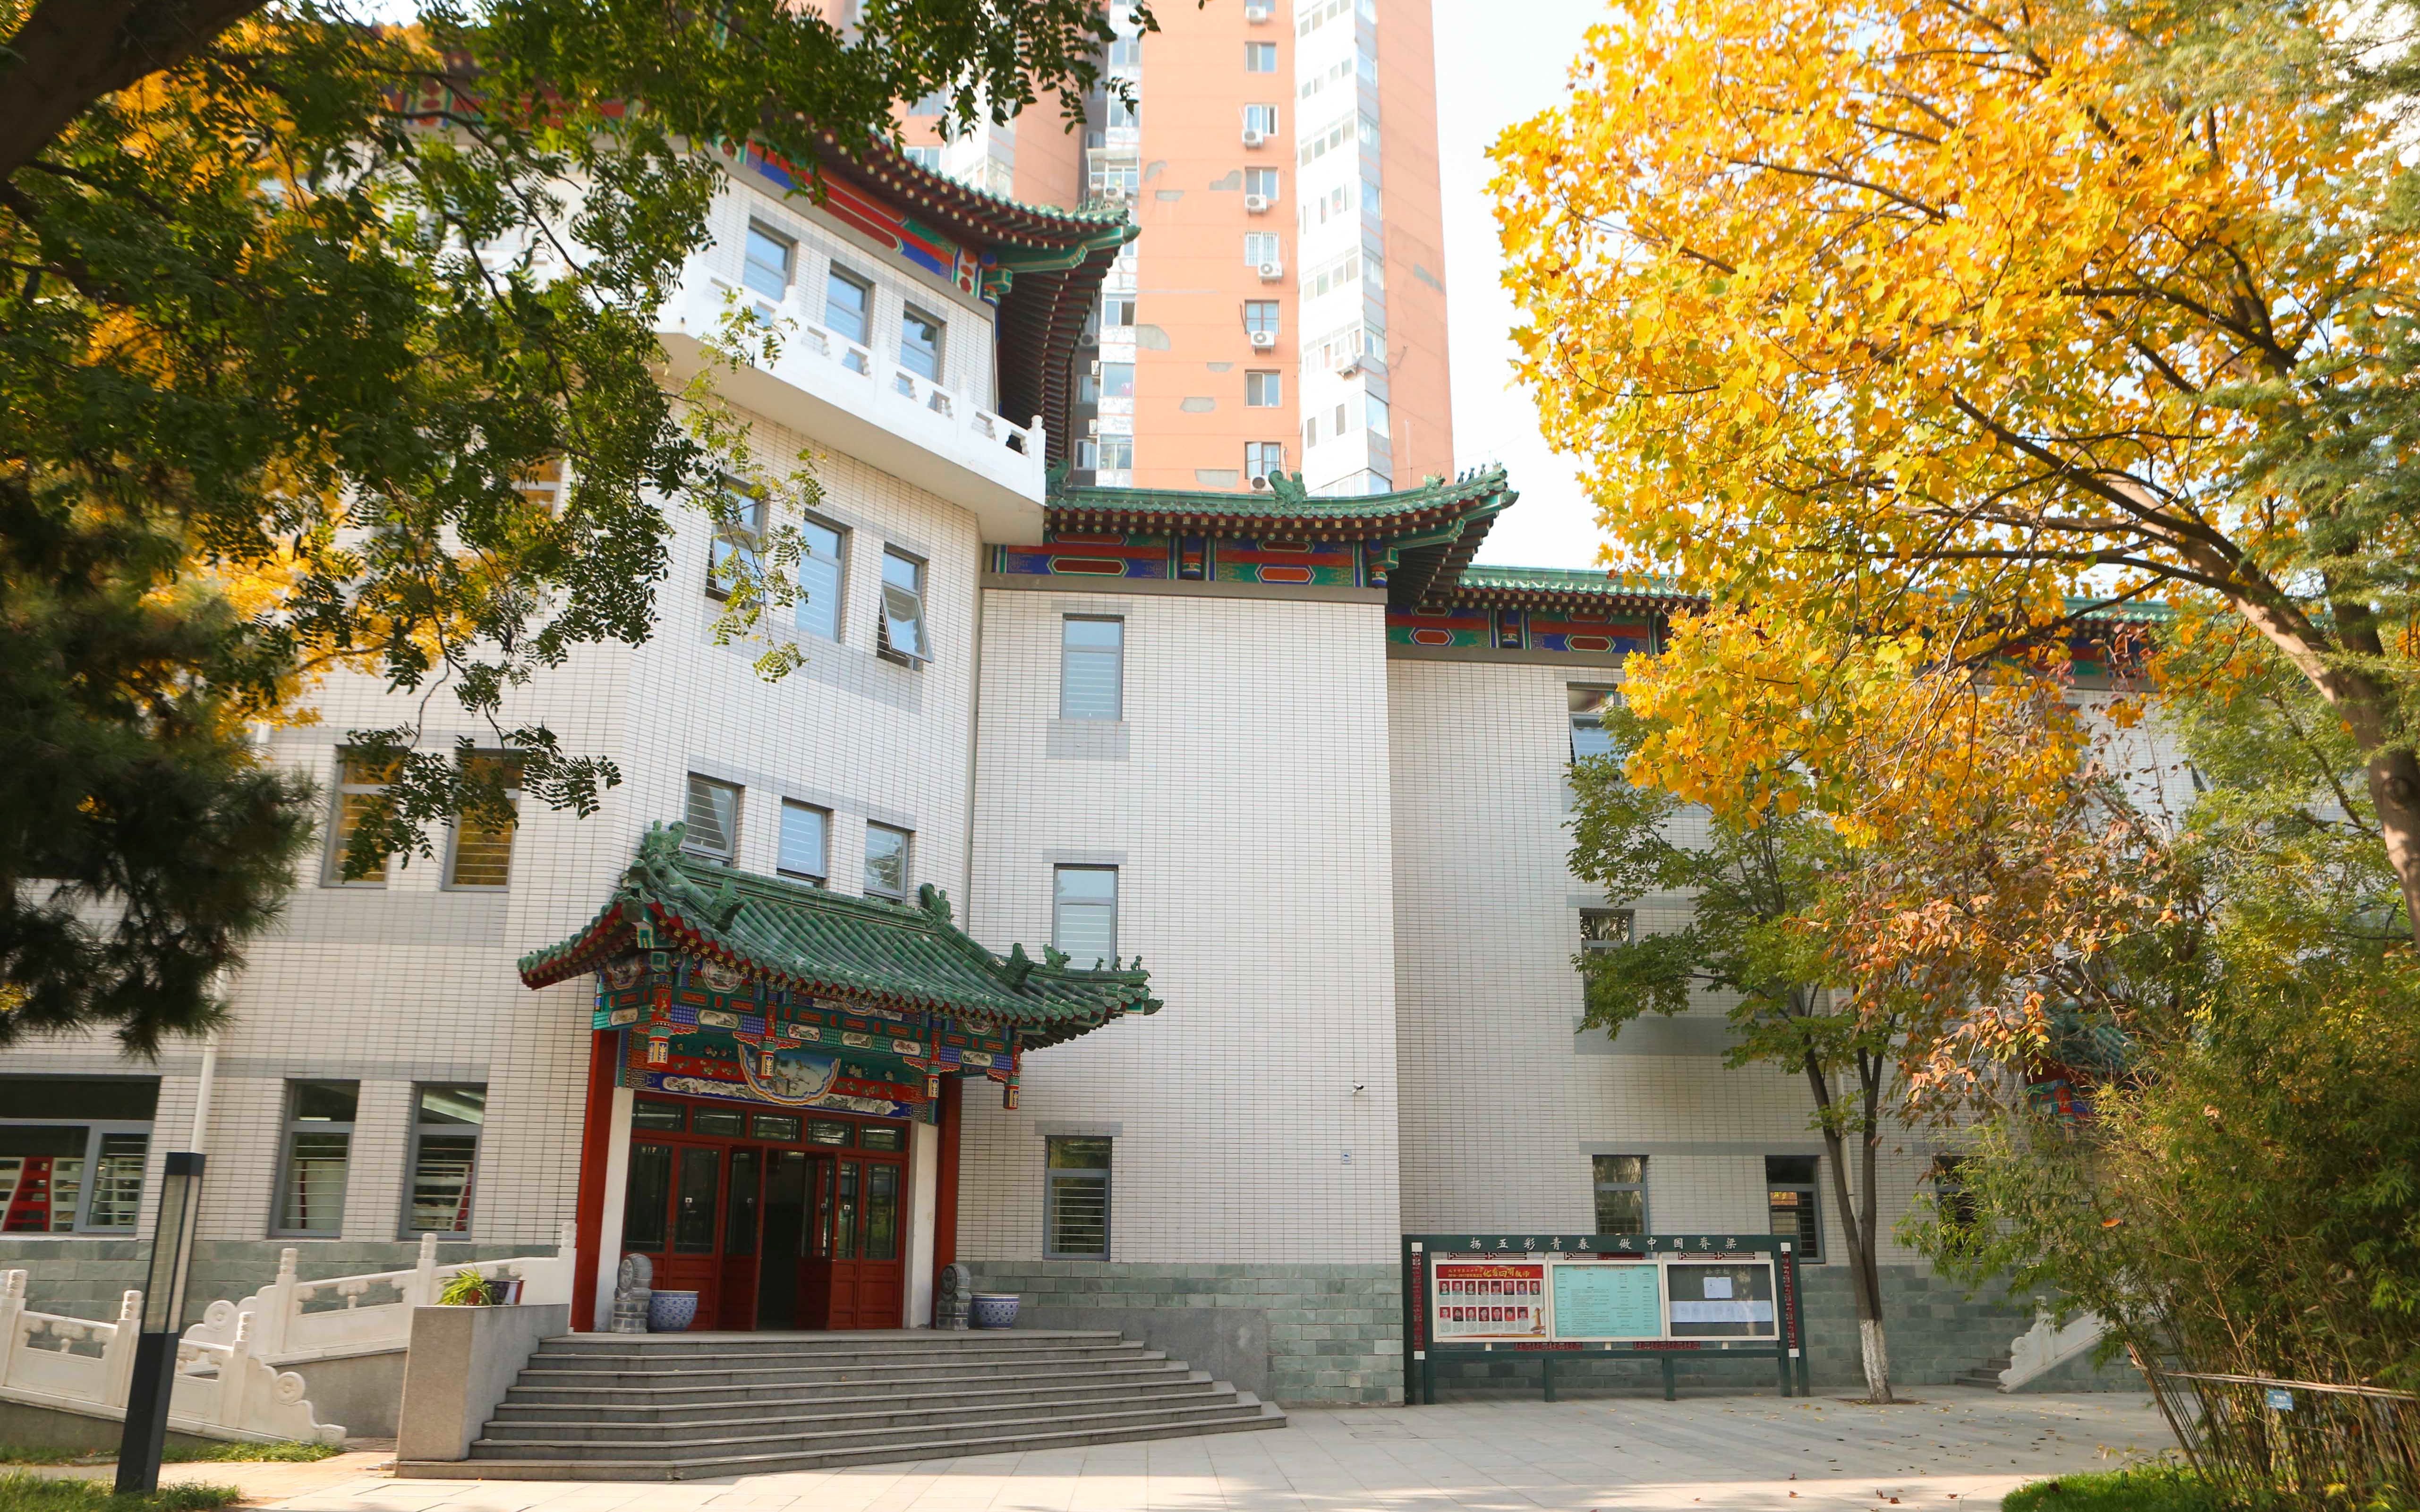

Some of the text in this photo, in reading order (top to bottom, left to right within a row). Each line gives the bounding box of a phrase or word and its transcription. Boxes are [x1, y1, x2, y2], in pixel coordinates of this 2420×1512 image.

[1469, 1236, 1738, 1250] 扬五彩青春 做中国脊梁
